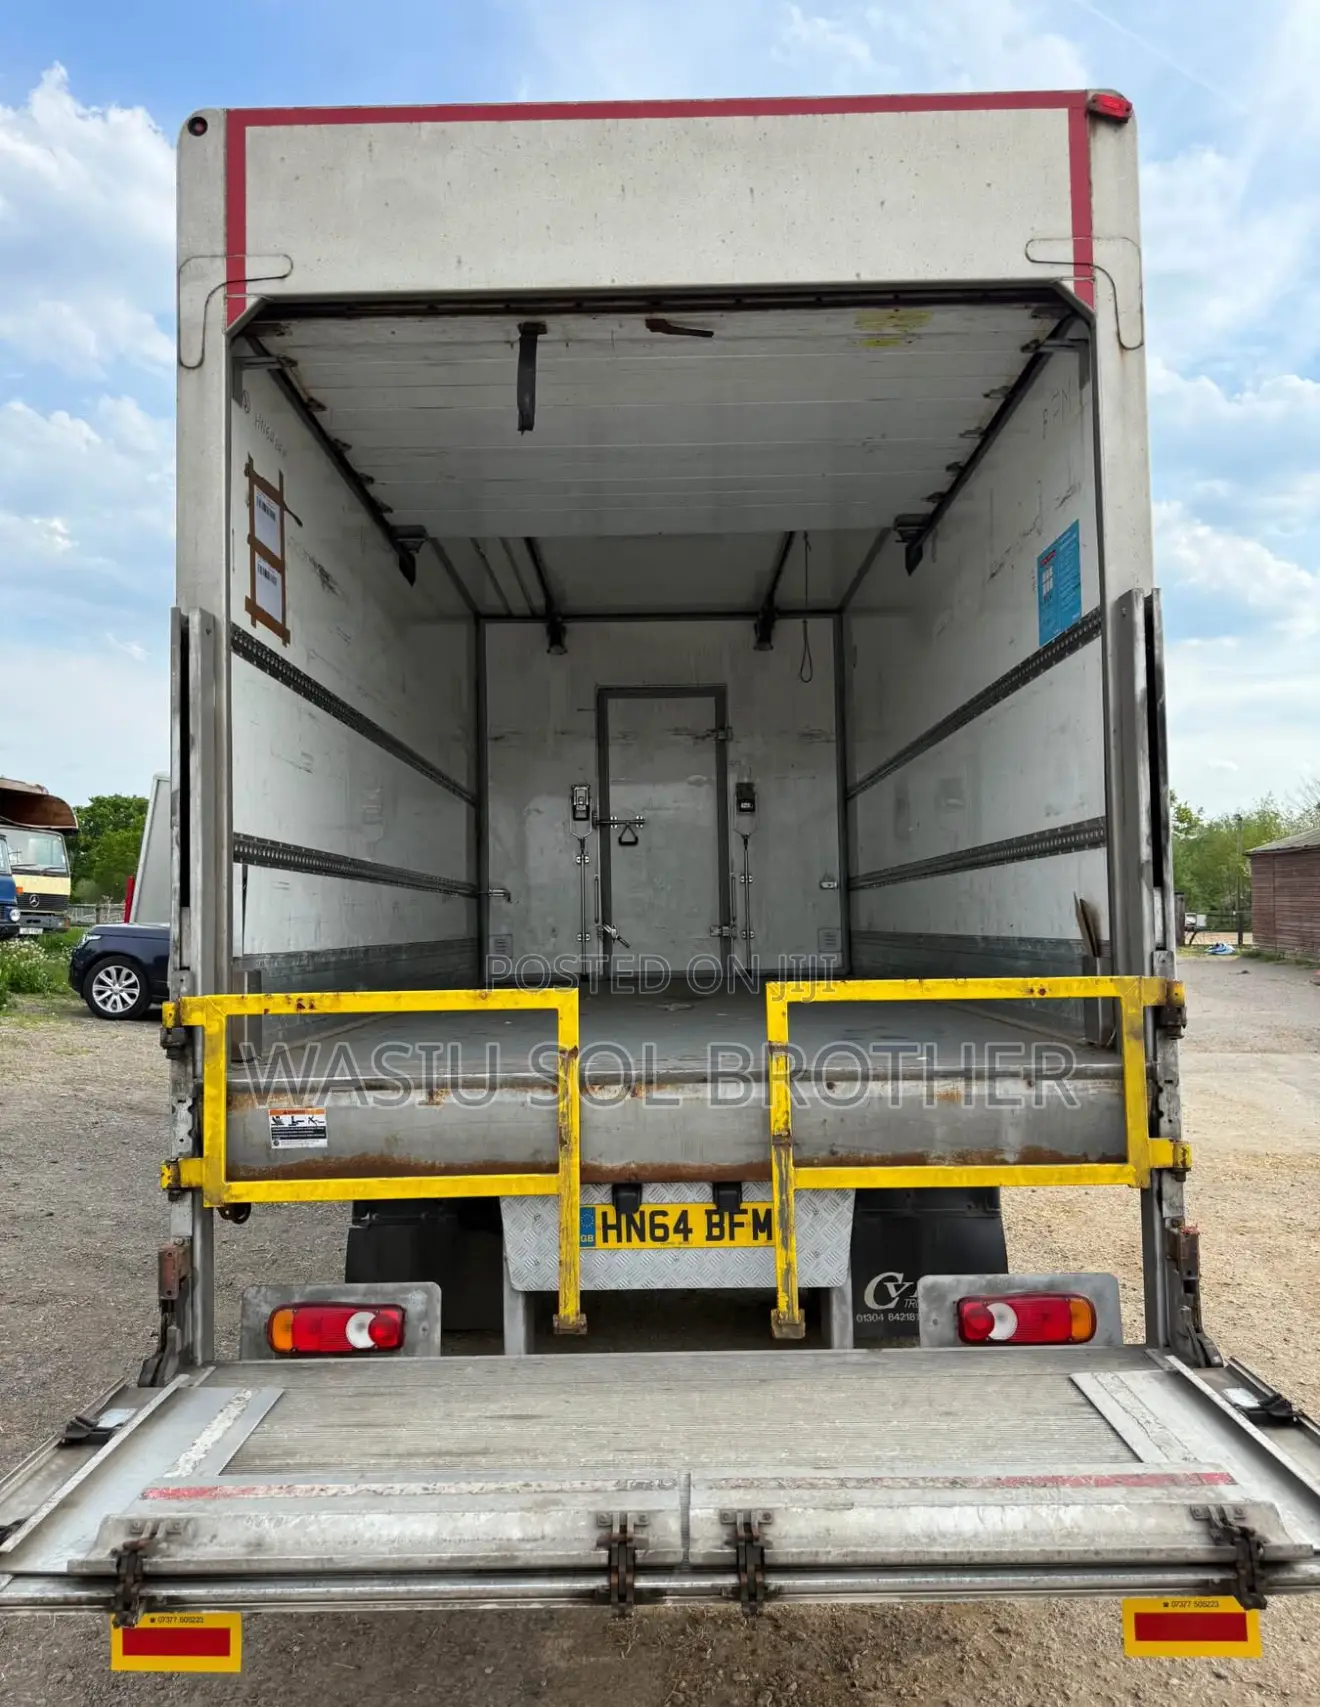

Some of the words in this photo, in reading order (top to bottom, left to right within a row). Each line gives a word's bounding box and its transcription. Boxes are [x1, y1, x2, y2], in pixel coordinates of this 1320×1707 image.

[601, 1209, 693, 1243] HN64
[705, 1208, 772, 1242] BFM
[580, 1234, 594, 1243] GB
[856, 1313, 884, 1323] 01304
